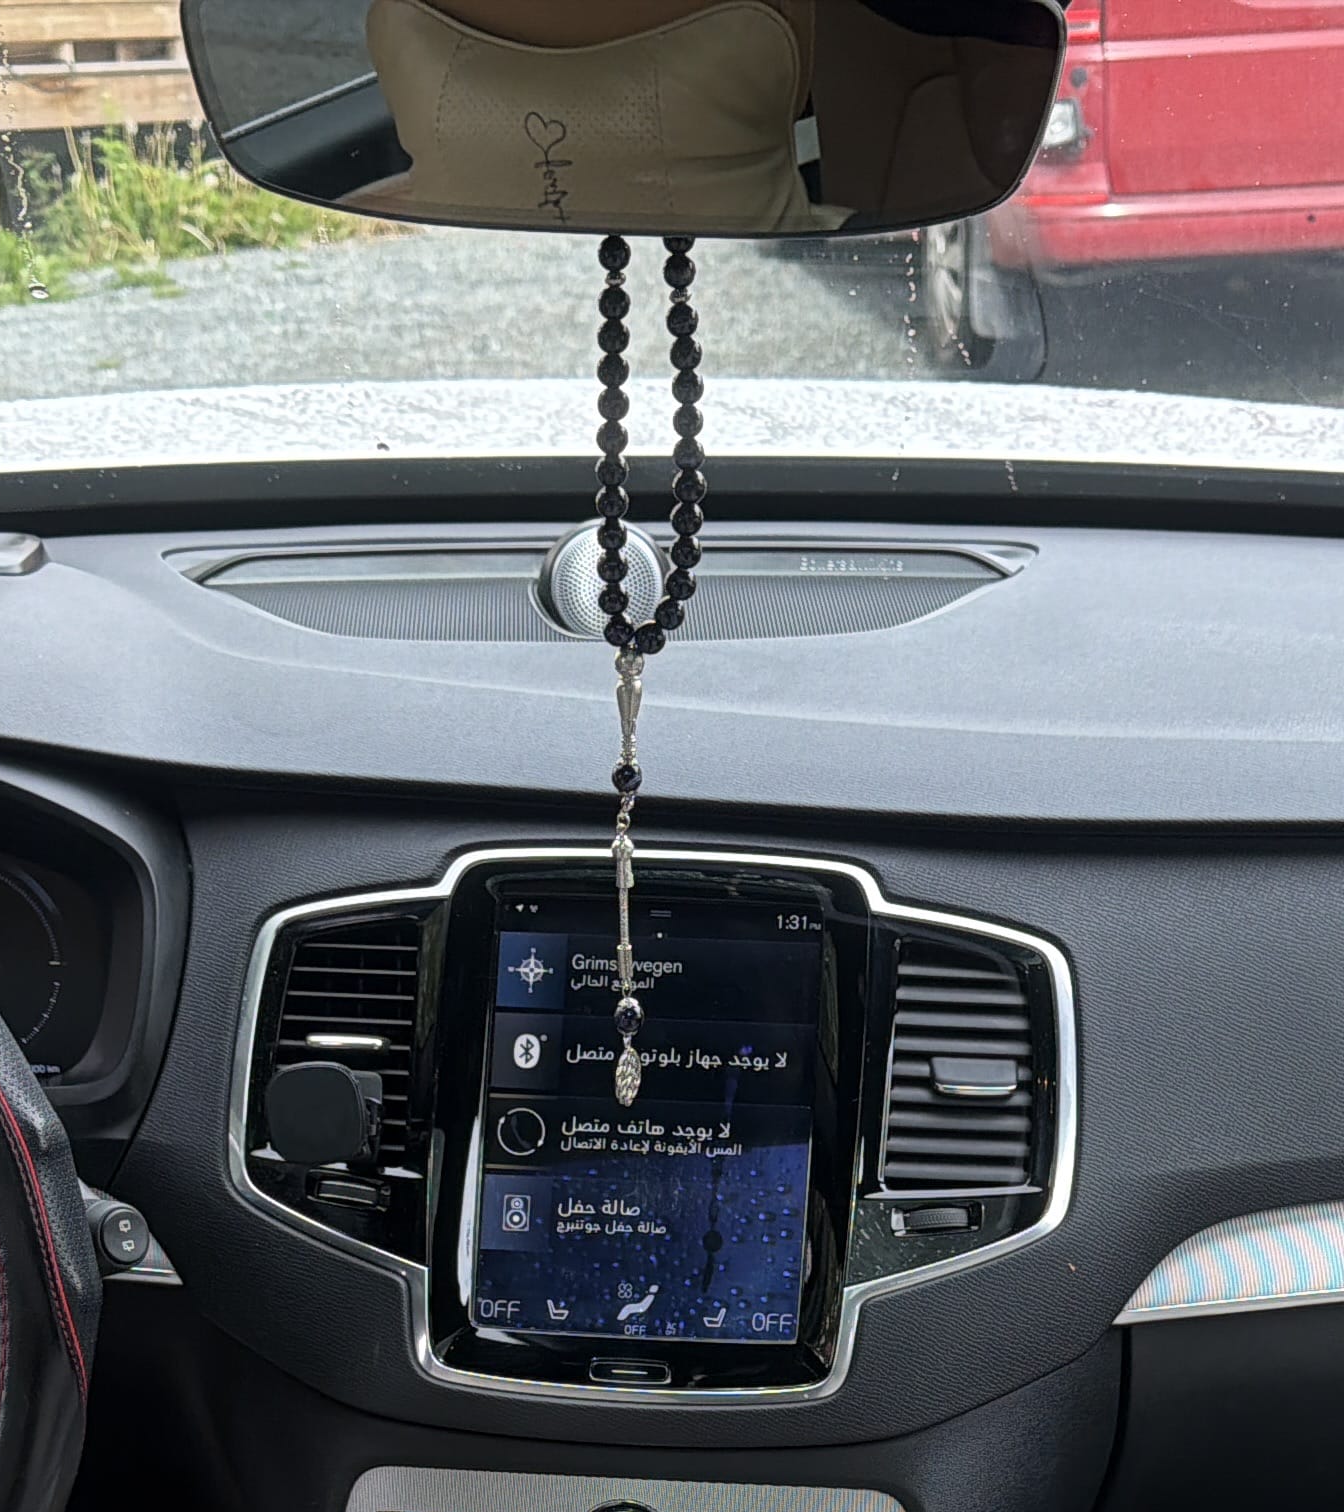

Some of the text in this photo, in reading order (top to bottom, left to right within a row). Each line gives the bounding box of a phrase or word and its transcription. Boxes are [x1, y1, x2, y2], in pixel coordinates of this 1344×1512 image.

[776, 914, 807, 930] 1:31
[571, 953, 683, 977] Grimsvegen
[611, 977, 655, 992] الموع
[566, 1044, 788, 1071] لا يوجد جهاز بلوتو متصل
[561, 1116, 731, 1141] لا يوجد هاتف متصل
[558, 1197, 641, 1217] صالة حفل
[605, 1219, 633, 1235] حفل
[637, 1219, 667, 1235] صالة
[480, 1299, 521, 1319] OFF
[624, 1324, 646, 1336] OFF
[751, 1312, 793, 1332] OFF
